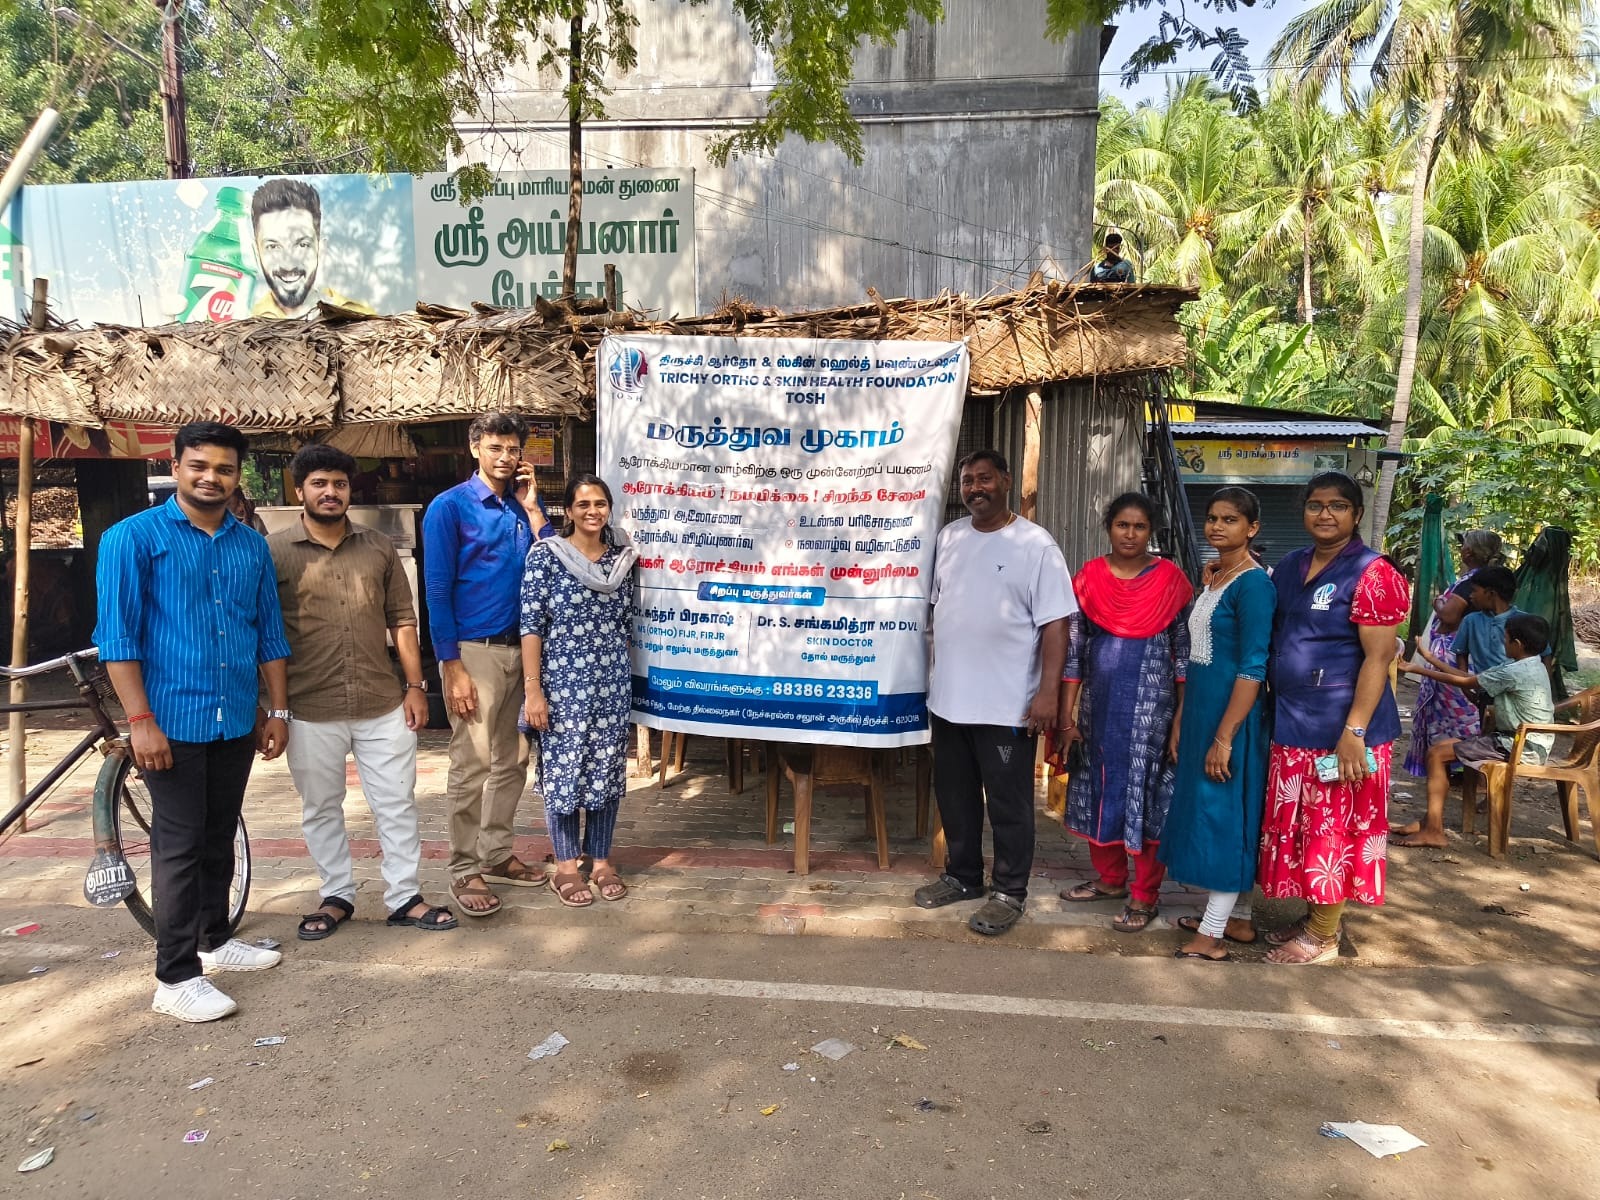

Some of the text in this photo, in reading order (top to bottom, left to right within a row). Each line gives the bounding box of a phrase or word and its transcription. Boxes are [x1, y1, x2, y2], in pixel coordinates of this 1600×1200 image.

[431, 176, 457, 202] ஸ்ரீ
[518, 176, 615, 196] மாரியமன்
[619, 178, 681, 200] துணை
[434, 206, 489, 267] ஸ்ரீ
[659, 353, 960, 372] திருச்சி ஆர்தோ & ஸ்கின் ஹெல்த் பவுண்டேஷன்
[660, 372, 957, 388] TRICHY ORTHO & SKIN HEALTH FOUNDATION
[785, 392, 825, 404] TOSH
[646, 416, 904, 453] மருத்துவ முகாம்
[619, 455, 931, 480] ஆரோக்கியமான வாழ்விற்கு ஒரு முன்னேற்றப் பயணம்
[622, 480, 716, 499] ஆரோக்கியம்
[728, 488, 808, 503] நம்பிக்கை
[822, 488, 872, 505] சிறந்த
[877, 488, 926, 503] சேவை
[674, 509, 742, 525] ஆலோசனை
[799, 514, 913, 530] உடல்நல பரிசோதனை
[633, 528, 754, 550] ஆரோக்கிய விழிப்புணர்வு
[797, 536, 921, 554] நலவாழ்வு வழிகாட்டுதல்
[636, 555, 919, 585] ங்கள் ஆரோக்கியம் எங்கள் முன்னுரிமை
[709, 585, 813, 601] சிறப்பு மருத்துவர்கள்
[680, 608, 734, 627] பிரகாஷ்
[757, 615, 918, 634] Dr. S. சங்கமித்ரா MD DVL
[647, 624, 677, 639] (ORTHO)
[700, 631, 725, 641] FIRJR
[806, 636, 873, 647] SKIN DOCTOR
[665, 644, 691, 656] எலும்பு
[694, 645, 739, 659] மருத்துவர்
[801, 651, 876, 666] தோல் மருத்துவர்
[651, 675, 683, 690] மேலும்
[684, 679, 763, 696] விவரங்களுக்கு
[772, 682, 824, 697] 88386
[826, 684, 872, 700] 23336
